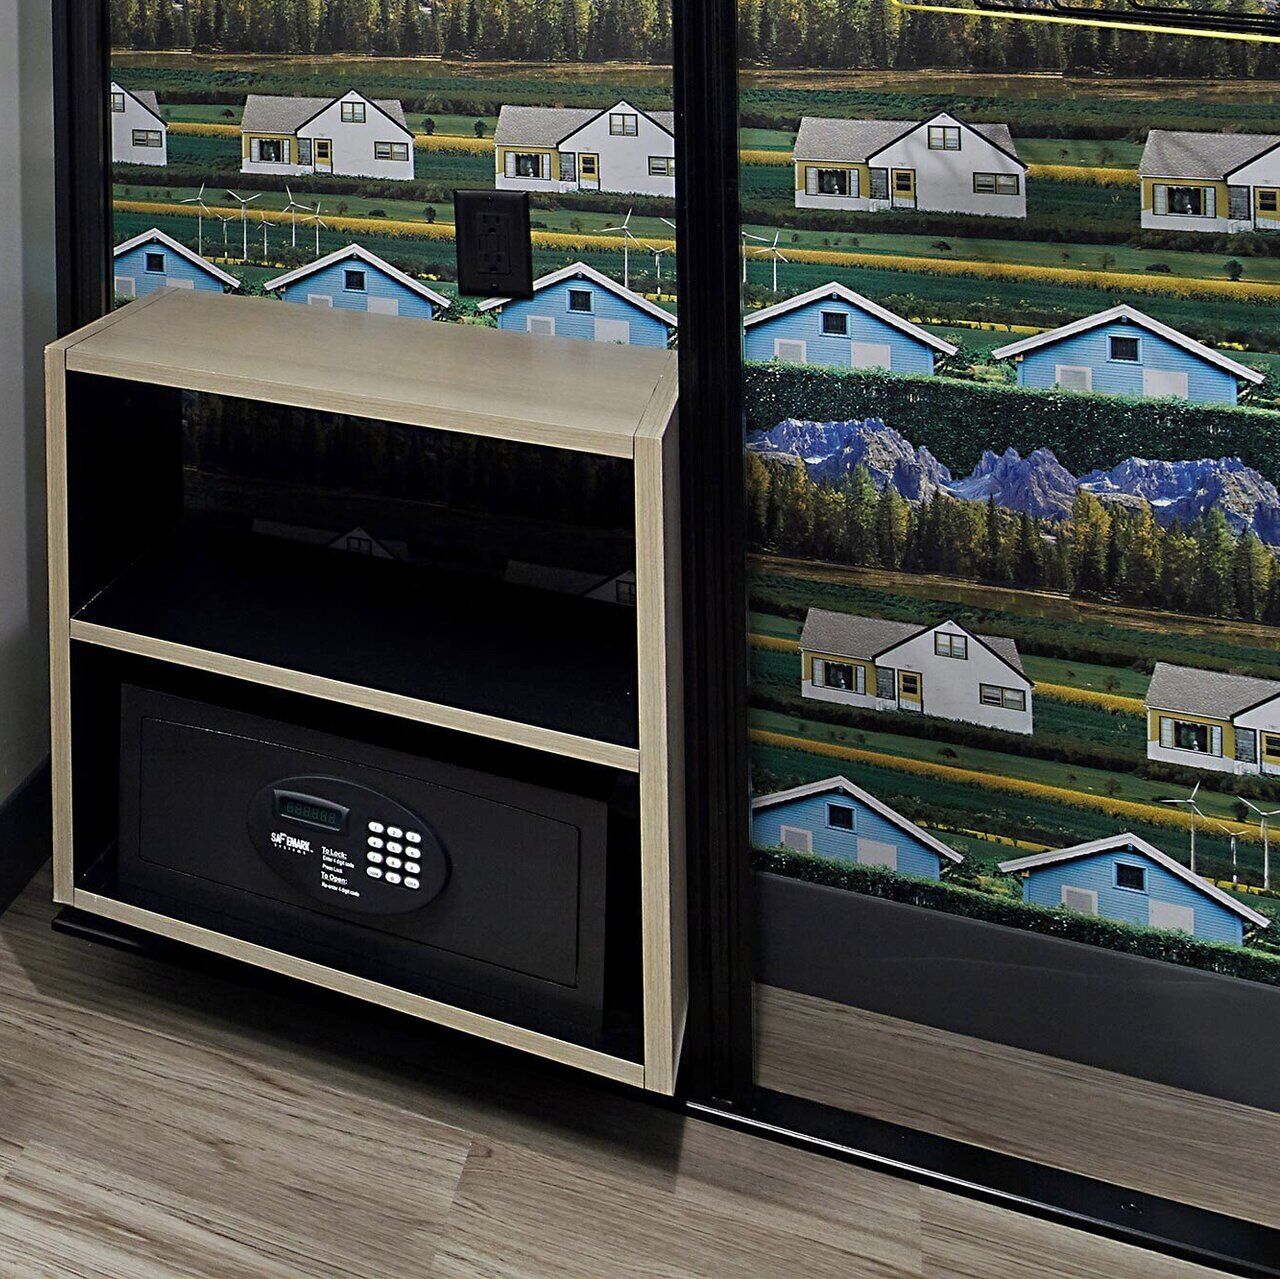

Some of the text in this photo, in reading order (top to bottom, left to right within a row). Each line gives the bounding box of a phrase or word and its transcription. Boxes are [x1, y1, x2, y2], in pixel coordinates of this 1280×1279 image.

[271, 832, 310, 852] SAFEMARK
[321, 846, 348, 860] To Lock:
[320, 871, 329, 880] To
